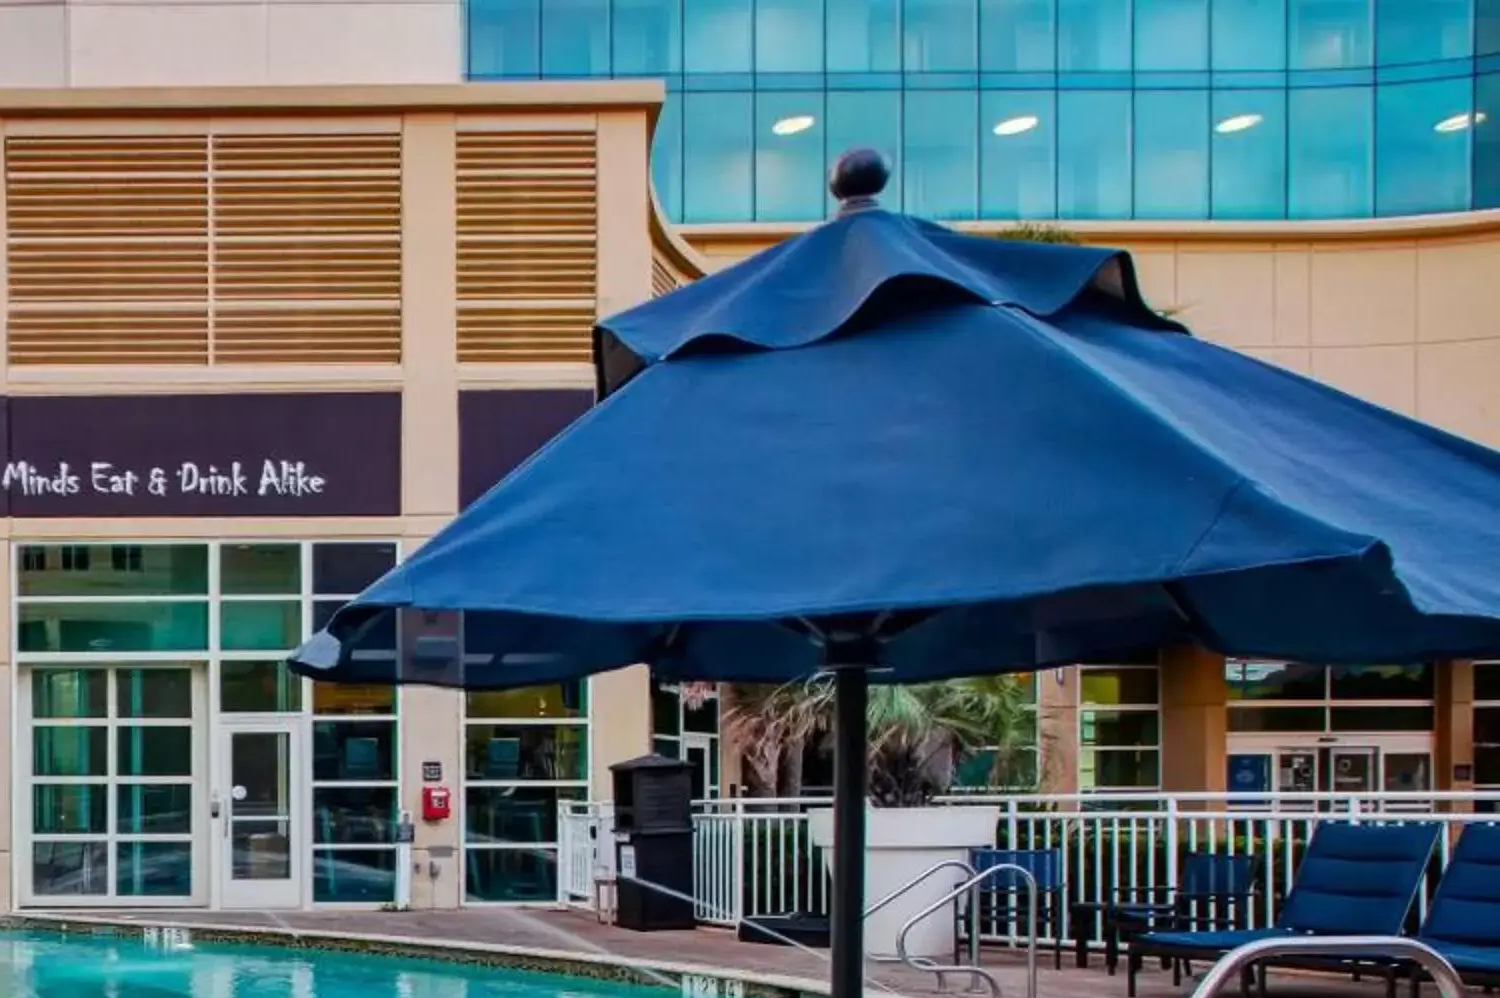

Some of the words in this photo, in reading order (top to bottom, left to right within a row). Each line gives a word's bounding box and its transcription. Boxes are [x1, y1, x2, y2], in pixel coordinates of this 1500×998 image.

[2, 460, 80, 497] Minds
[91, 461, 139, 496] Eat
[148, 466, 168, 496] &
[177, 461, 247, 496] Drink
[258, 458, 326, 497] Alike
